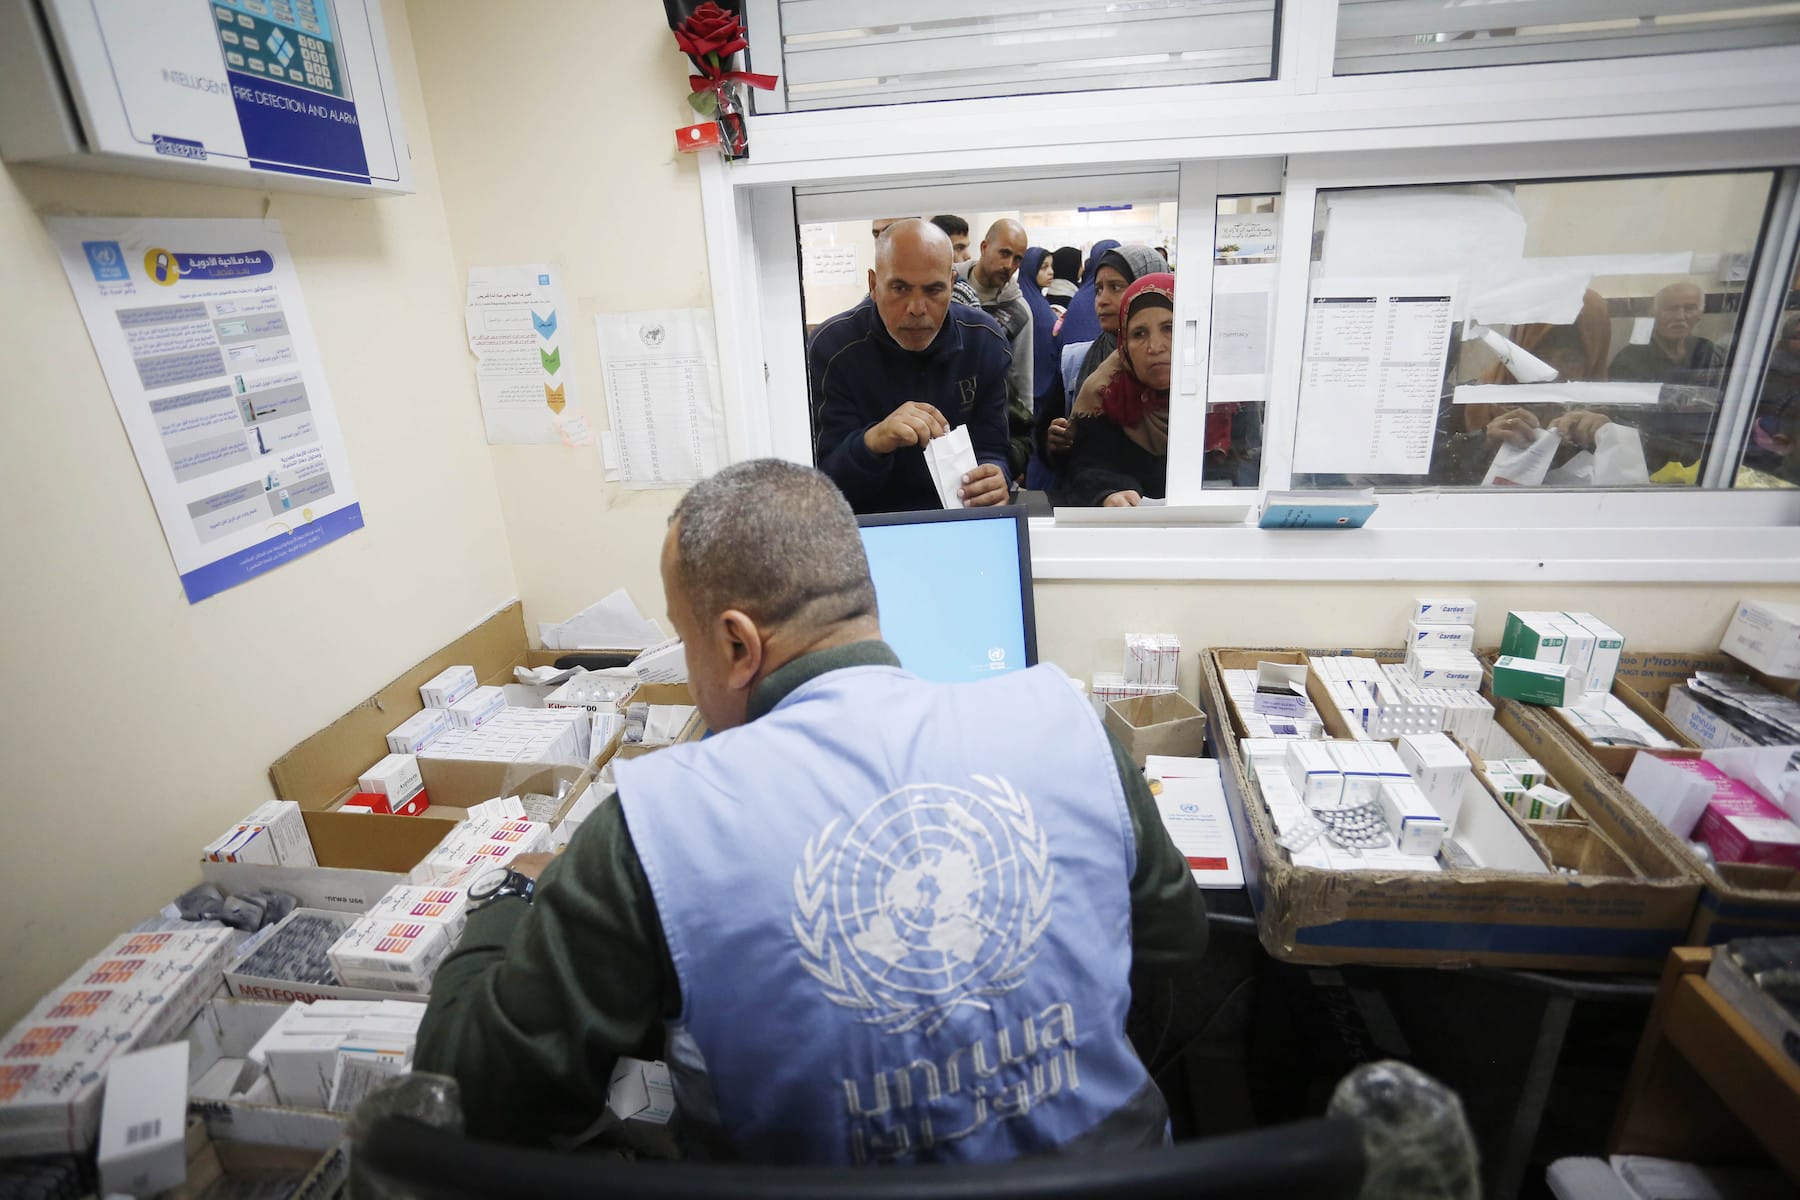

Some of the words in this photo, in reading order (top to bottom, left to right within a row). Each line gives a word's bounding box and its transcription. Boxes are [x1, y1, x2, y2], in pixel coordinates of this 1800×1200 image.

[161, 68, 229, 95] INTELLIGENT
[233, 85, 254, 103] FIRE
[254, 90, 306, 114] DETECTION
[307, 103, 328, 119] AND
[329, 107, 358, 125] ALARM
